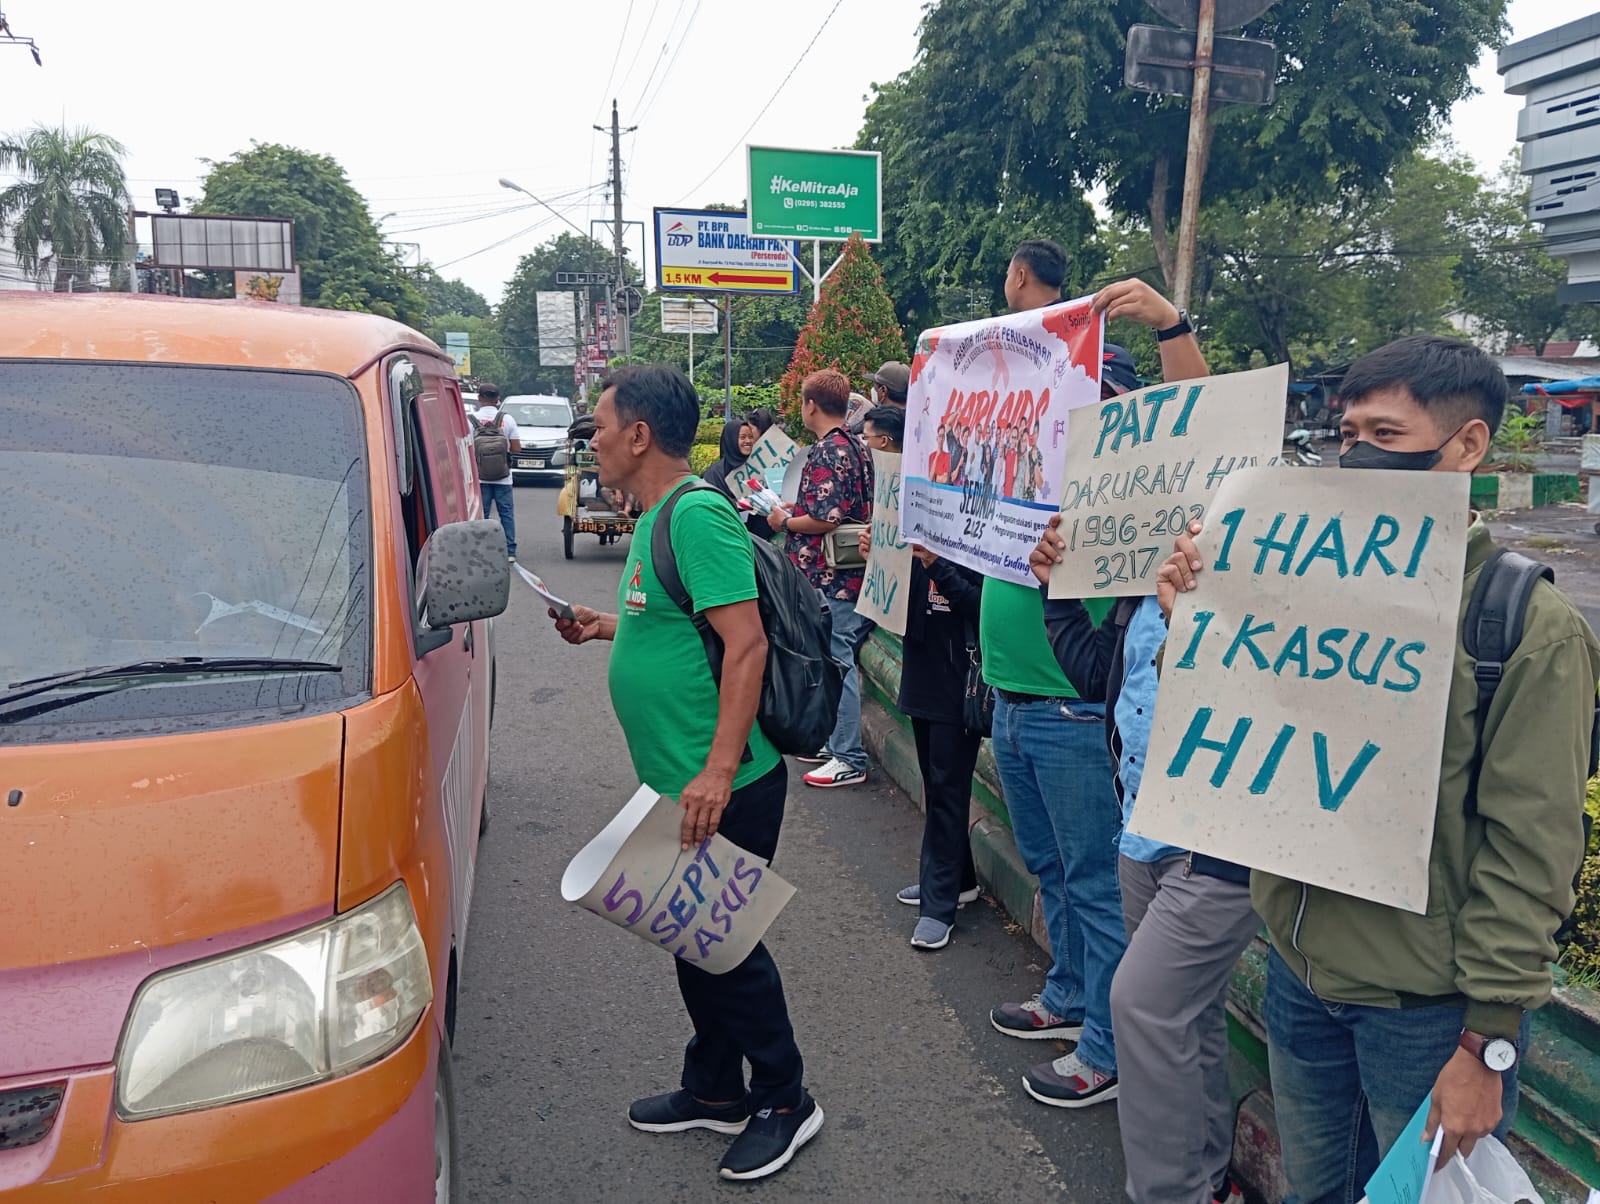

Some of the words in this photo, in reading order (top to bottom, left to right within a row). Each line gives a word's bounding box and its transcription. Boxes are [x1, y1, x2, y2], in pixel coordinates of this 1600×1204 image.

[770, 175, 859, 198] #KeMitraAja
[667, 233, 693, 246] BDP
[698, 221, 709, 231] PT.
[711, 221, 729, 232] BPR
[698, 232, 725, 248] BANK
[751, 247, 788, 260] (Perseroda)
[684, 273, 702, 284] KM
[1001, 327, 1052, 366] PERUBAHAN
[1093, 385, 1206, 458] PATI
[734, 439, 777, 493] PATI
[1213, 508, 1246, 572] 1
[1254, 511, 1434, 579] HARI
[1003, 555, 1031, 576] Ending
[1093, 547, 1160, 590] 3217
[1175, 610, 1215, 669] 1
[1222, 613, 1427, 692] KASUS
[1166, 707, 1381, 812] HIV
[651, 837, 720, 945] SEPT
